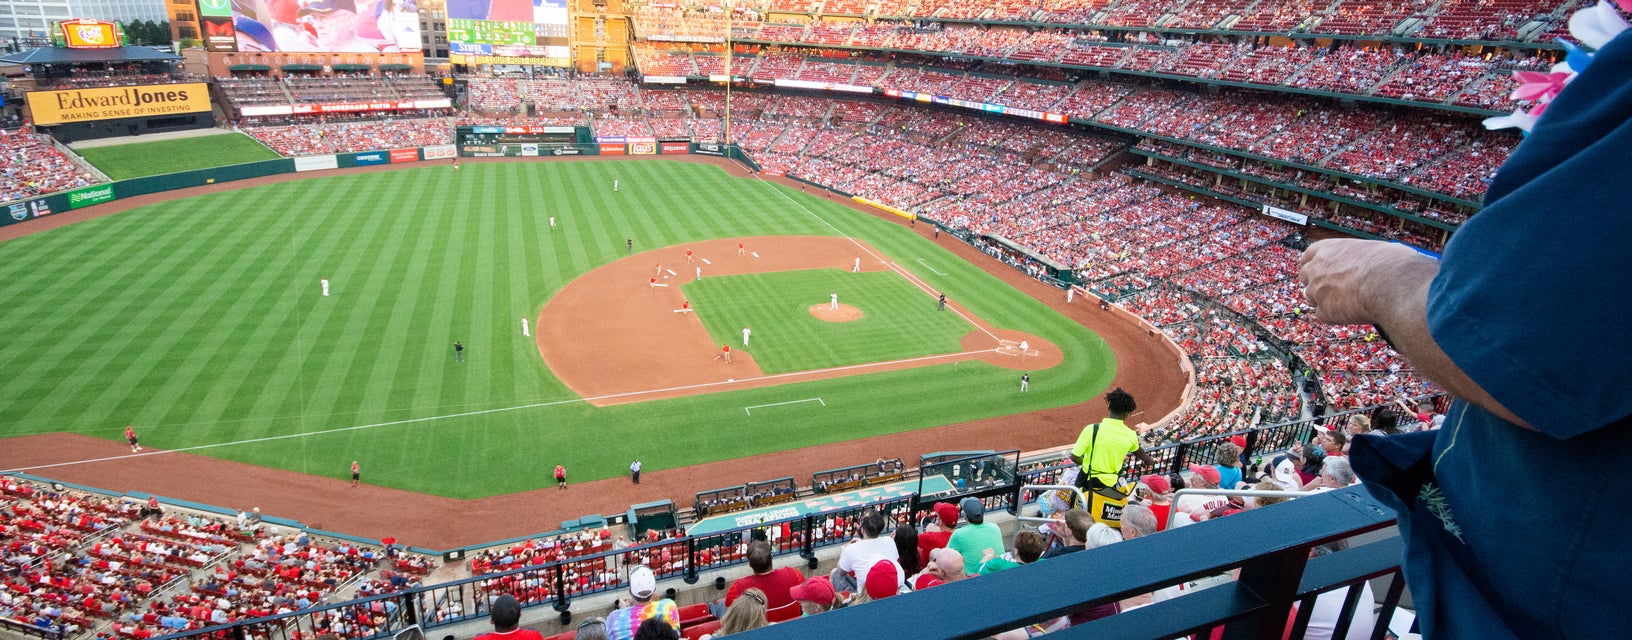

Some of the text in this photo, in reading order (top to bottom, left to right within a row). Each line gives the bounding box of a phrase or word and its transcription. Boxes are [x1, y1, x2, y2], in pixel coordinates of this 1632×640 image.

[458, 43, 483, 52] STIFEL
[489, 56, 507, 64] LOUIS
[56, 88, 189, 110] Edward Jones
[61, 111, 99, 120] MAKING
[102, 109, 131, 117] SENSE
[147, 104, 191, 113] INVESTING
[80, 187, 112, 201] National
